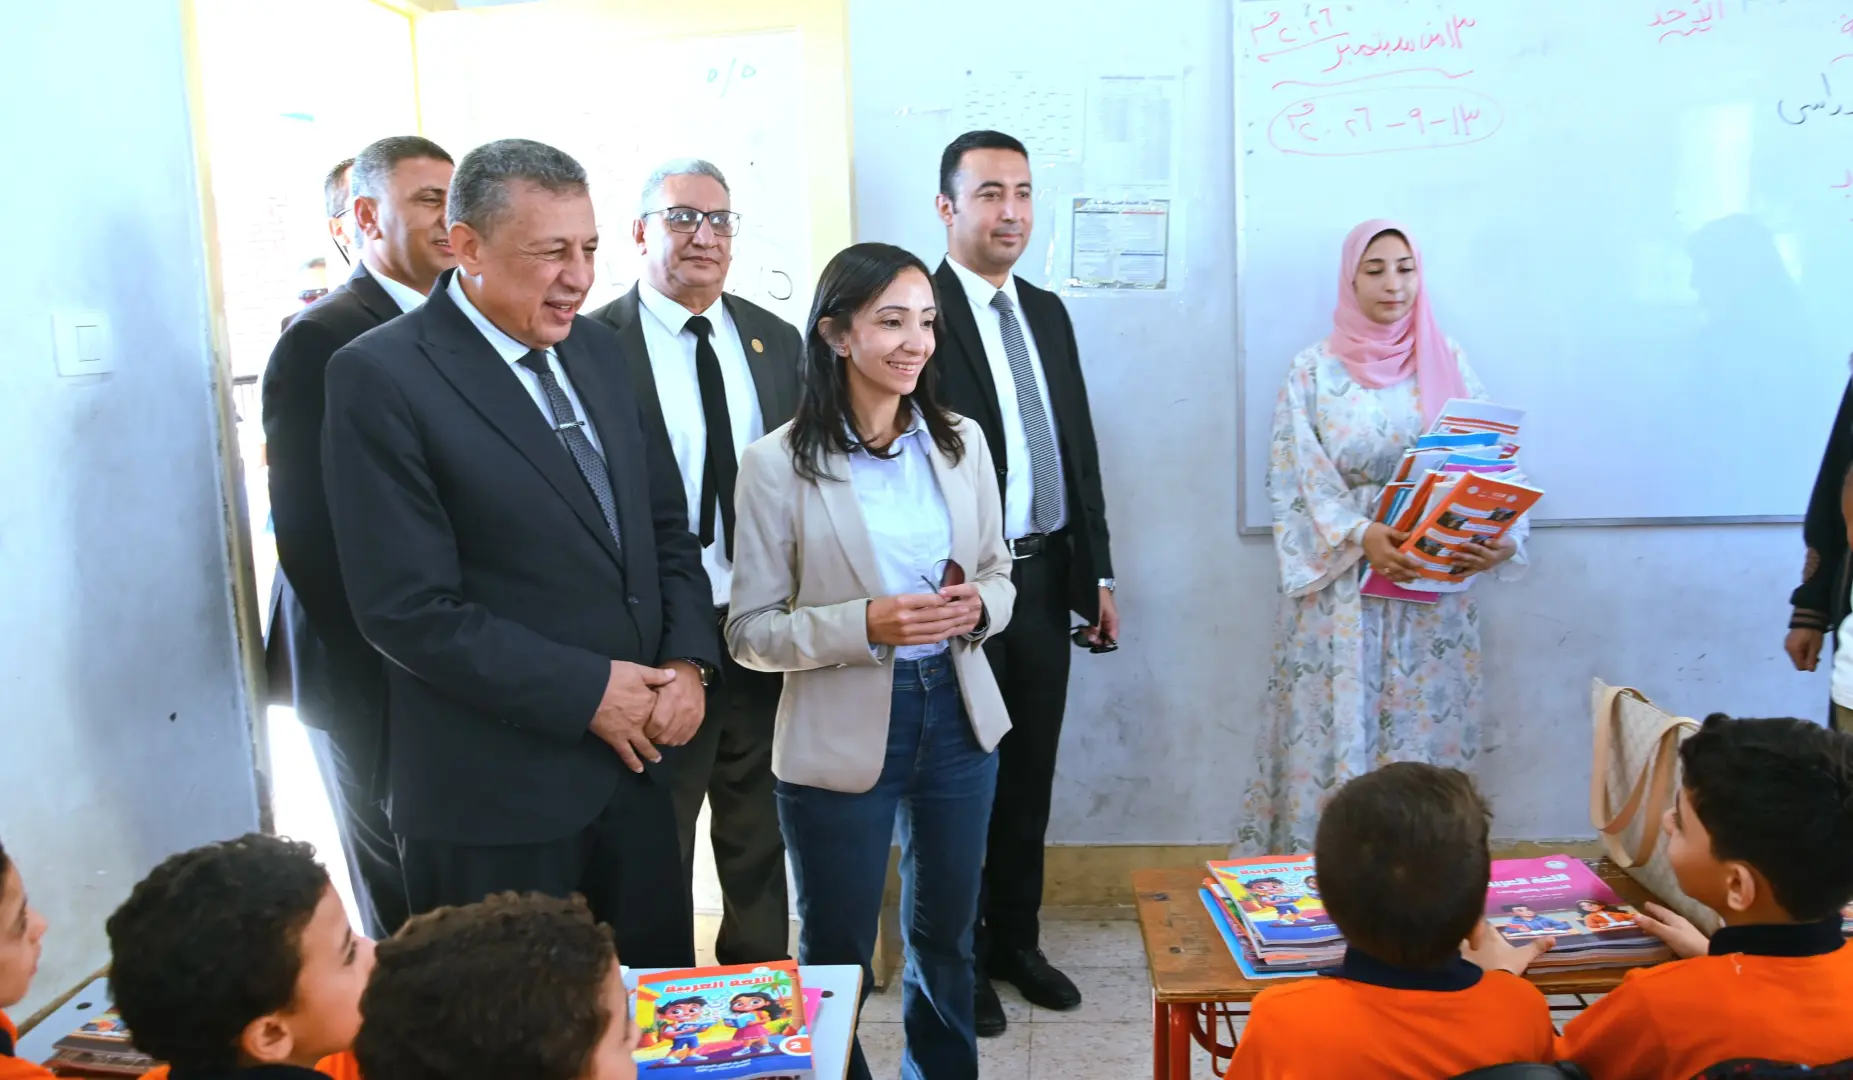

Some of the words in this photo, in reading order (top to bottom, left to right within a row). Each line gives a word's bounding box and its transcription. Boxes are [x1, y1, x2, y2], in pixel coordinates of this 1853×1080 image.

[664, 980, 725, 994] العربية
[729, 975, 774, 988] اللغة
[789, 1041, 802, 1050] 2
